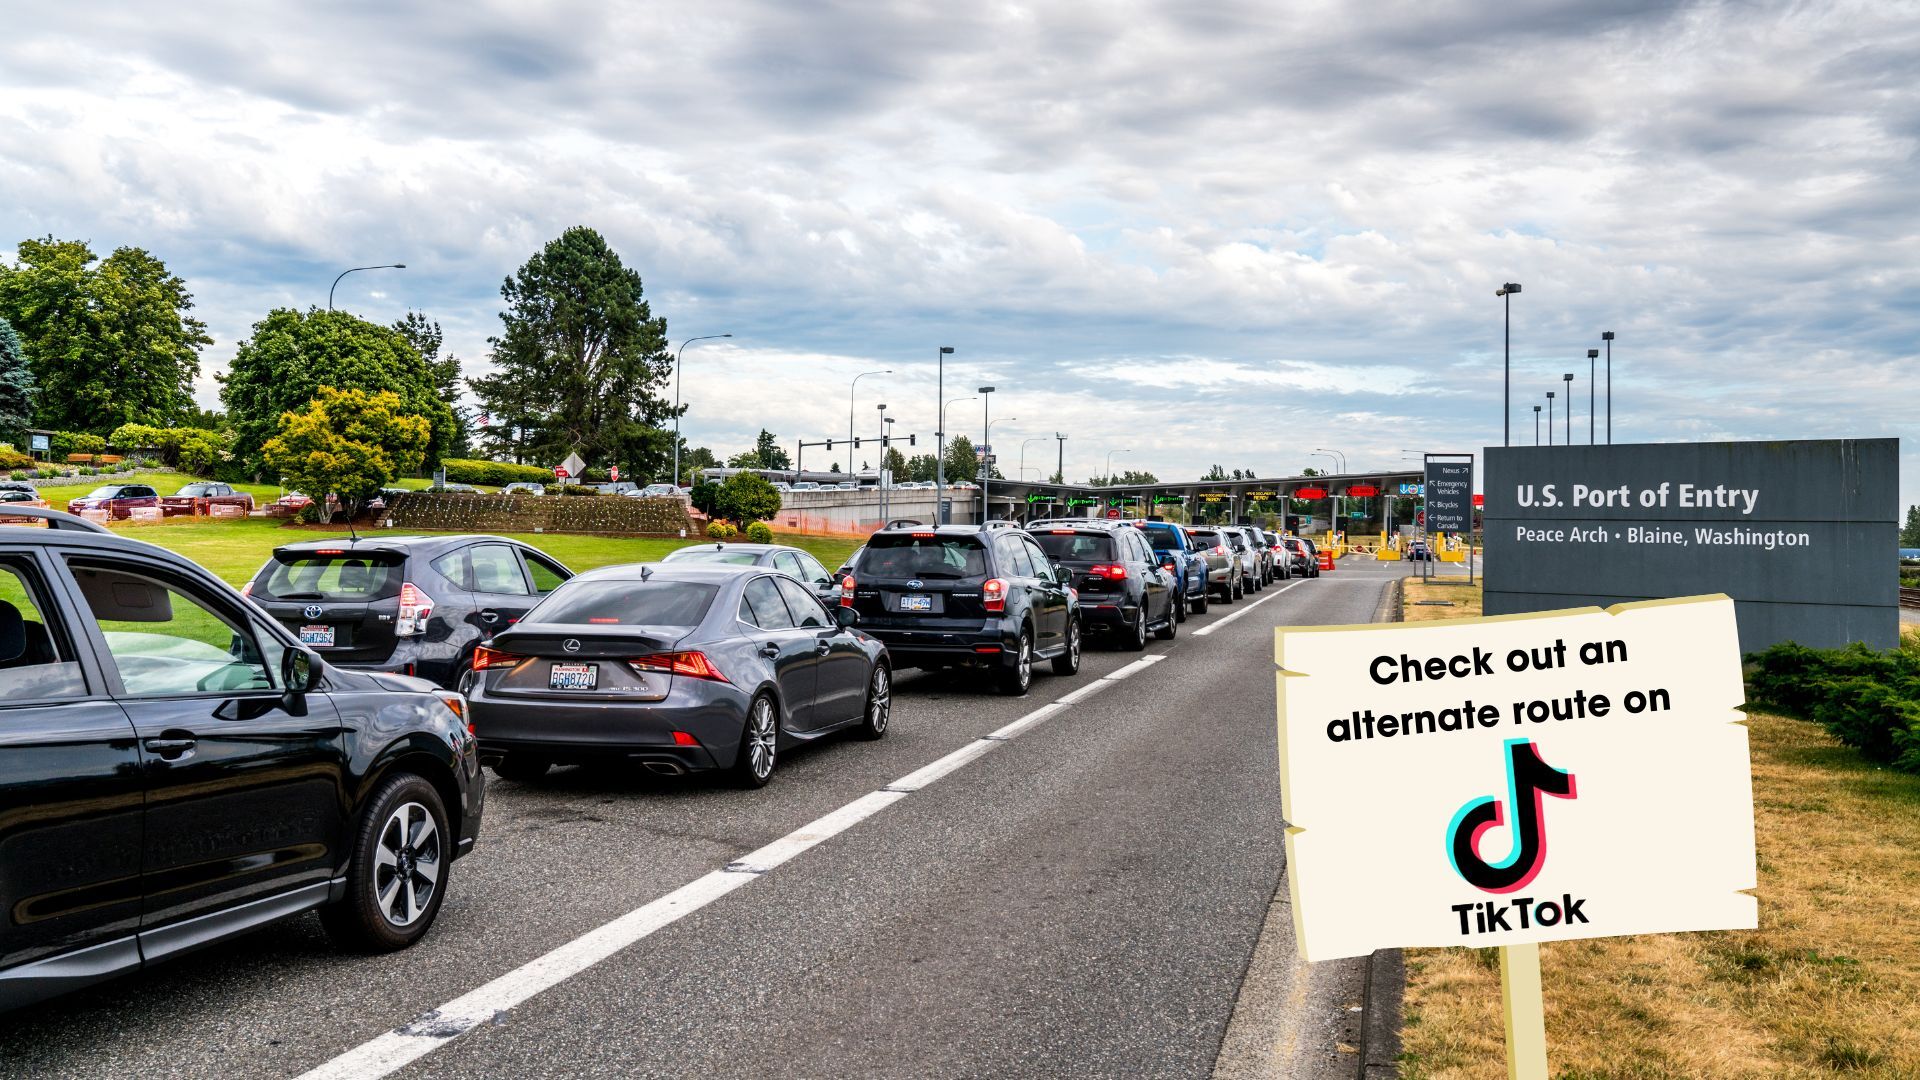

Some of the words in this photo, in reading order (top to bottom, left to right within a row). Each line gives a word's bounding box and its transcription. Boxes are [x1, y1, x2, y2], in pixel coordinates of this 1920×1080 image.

[1437, 481, 1467, 489] Emergency
[1518, 485, 1563, 507] U.S.
[1574, 485, 1630, 507] Port
[1640, 482, 1669, 507] of
[1680, 484, 1759, 514] Entry
[1437, 501, 1458, 509] Bicycles
[1516, 526, 1564, 542] Peace
[1570, 526, 1608, 543] Arch
[1628, 527, 1688, 546] Blaine,
[1695, 527, 1810, 550] Washington
[301, 632, 333, 643] BGH7962
[552, 672, 595, 686] BGH8720
